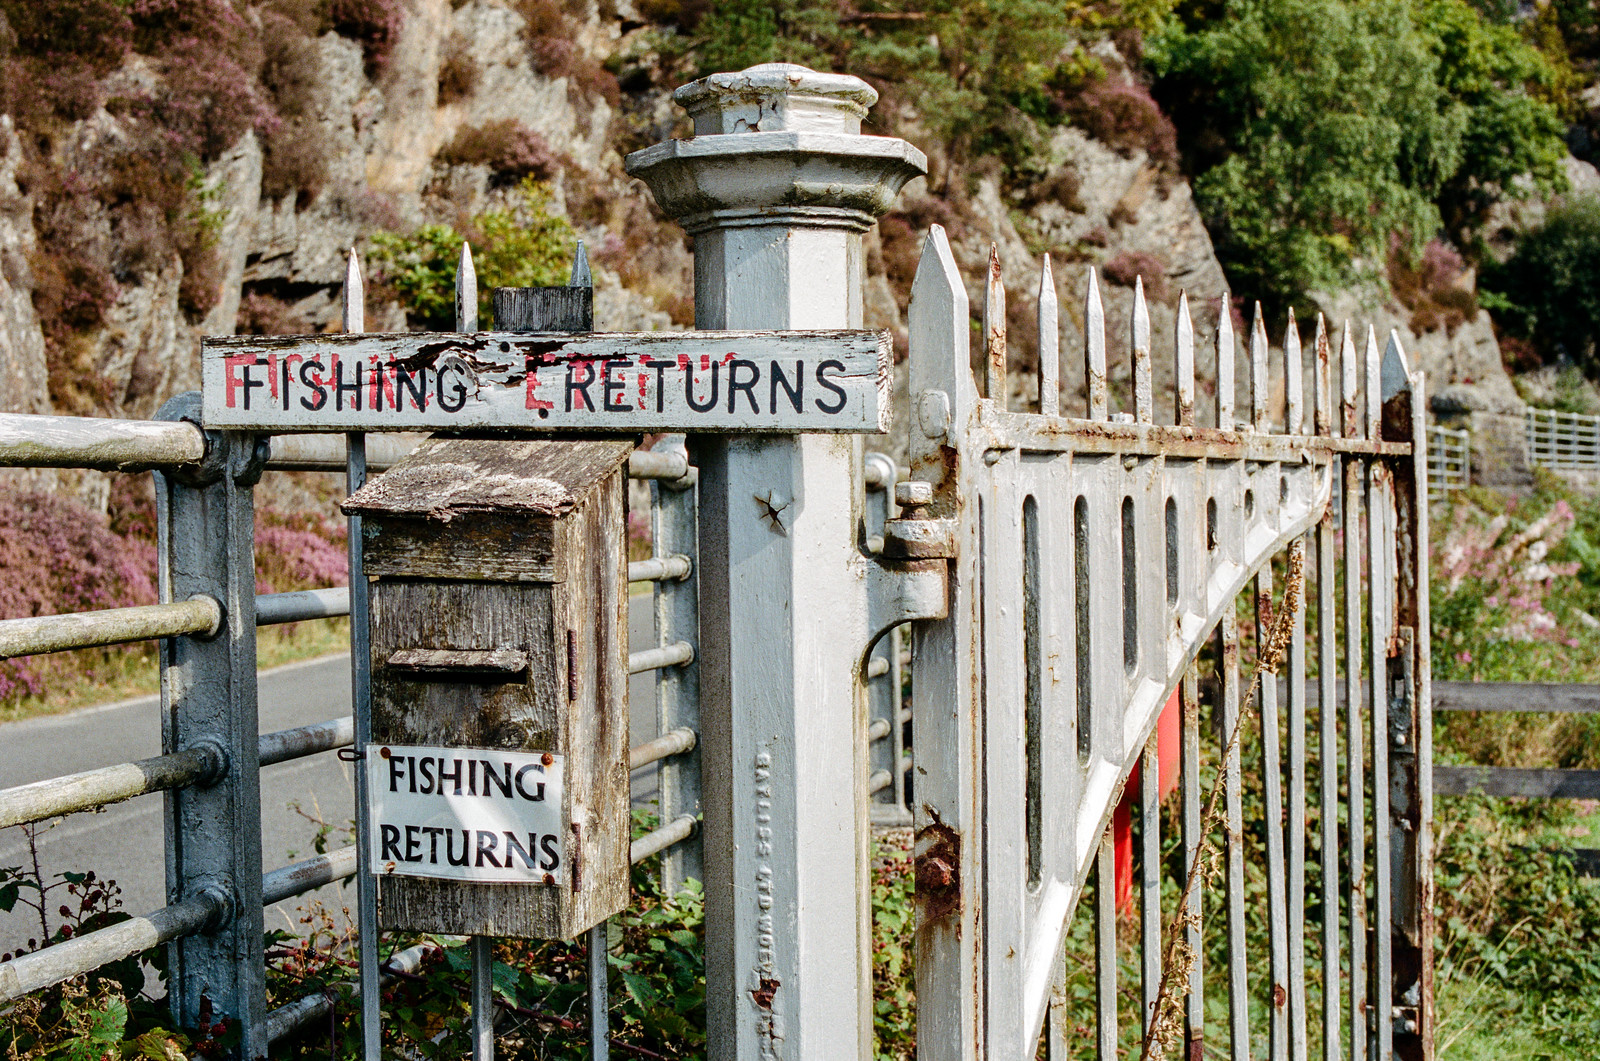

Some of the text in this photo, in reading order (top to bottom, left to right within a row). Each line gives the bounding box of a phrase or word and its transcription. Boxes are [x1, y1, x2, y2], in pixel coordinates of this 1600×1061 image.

[242, 358, 468, 414] FISHING
[564, 359, 848, 415] RETURNS
[388, 755, 546, 802] FISHING
[380, 823, 560, 872] RETURNS
